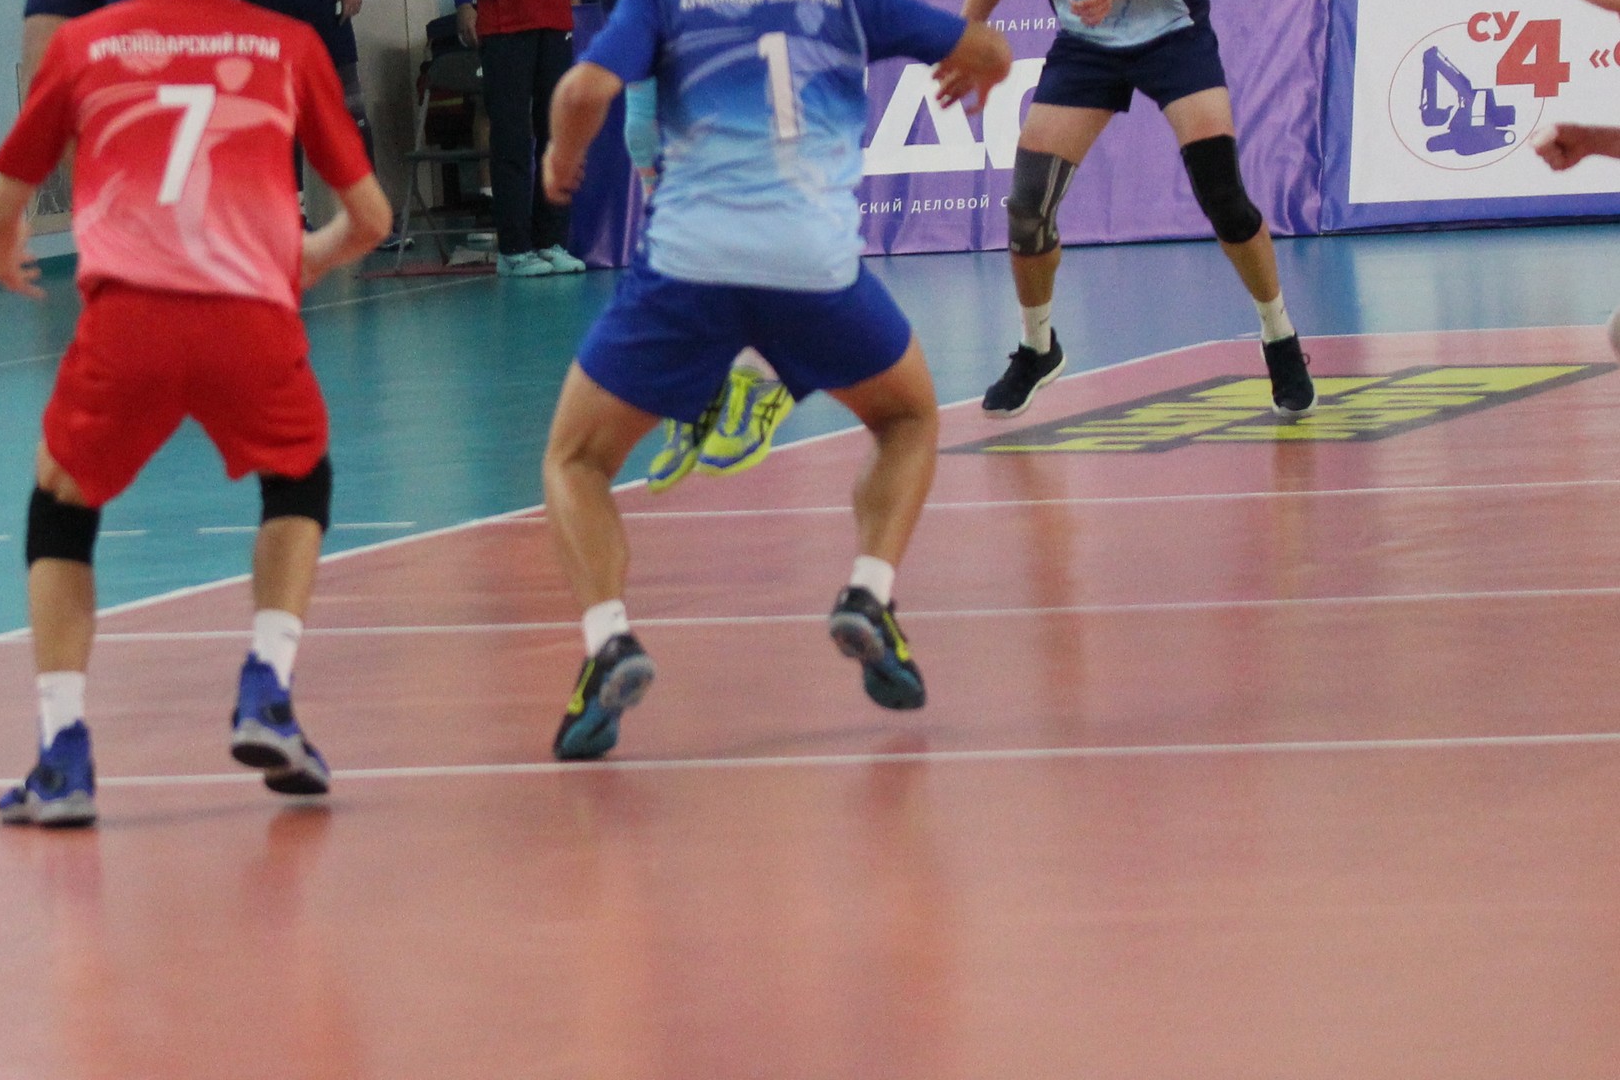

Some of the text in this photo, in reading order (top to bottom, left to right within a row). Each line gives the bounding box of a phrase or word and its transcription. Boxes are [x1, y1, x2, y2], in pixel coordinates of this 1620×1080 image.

[986, 17, 1056, 33] ПАНИЯ
[1467, 10, 1521, 42] СУ
[1496, 18, 1570, 98] 4
[757, 32, 799, 139] 1
[157, 84, 217, 206] 7
[859, 197, 902, 215] СКИЙ
[911, 194, 990, 214] ДЕЛОВОЙ
